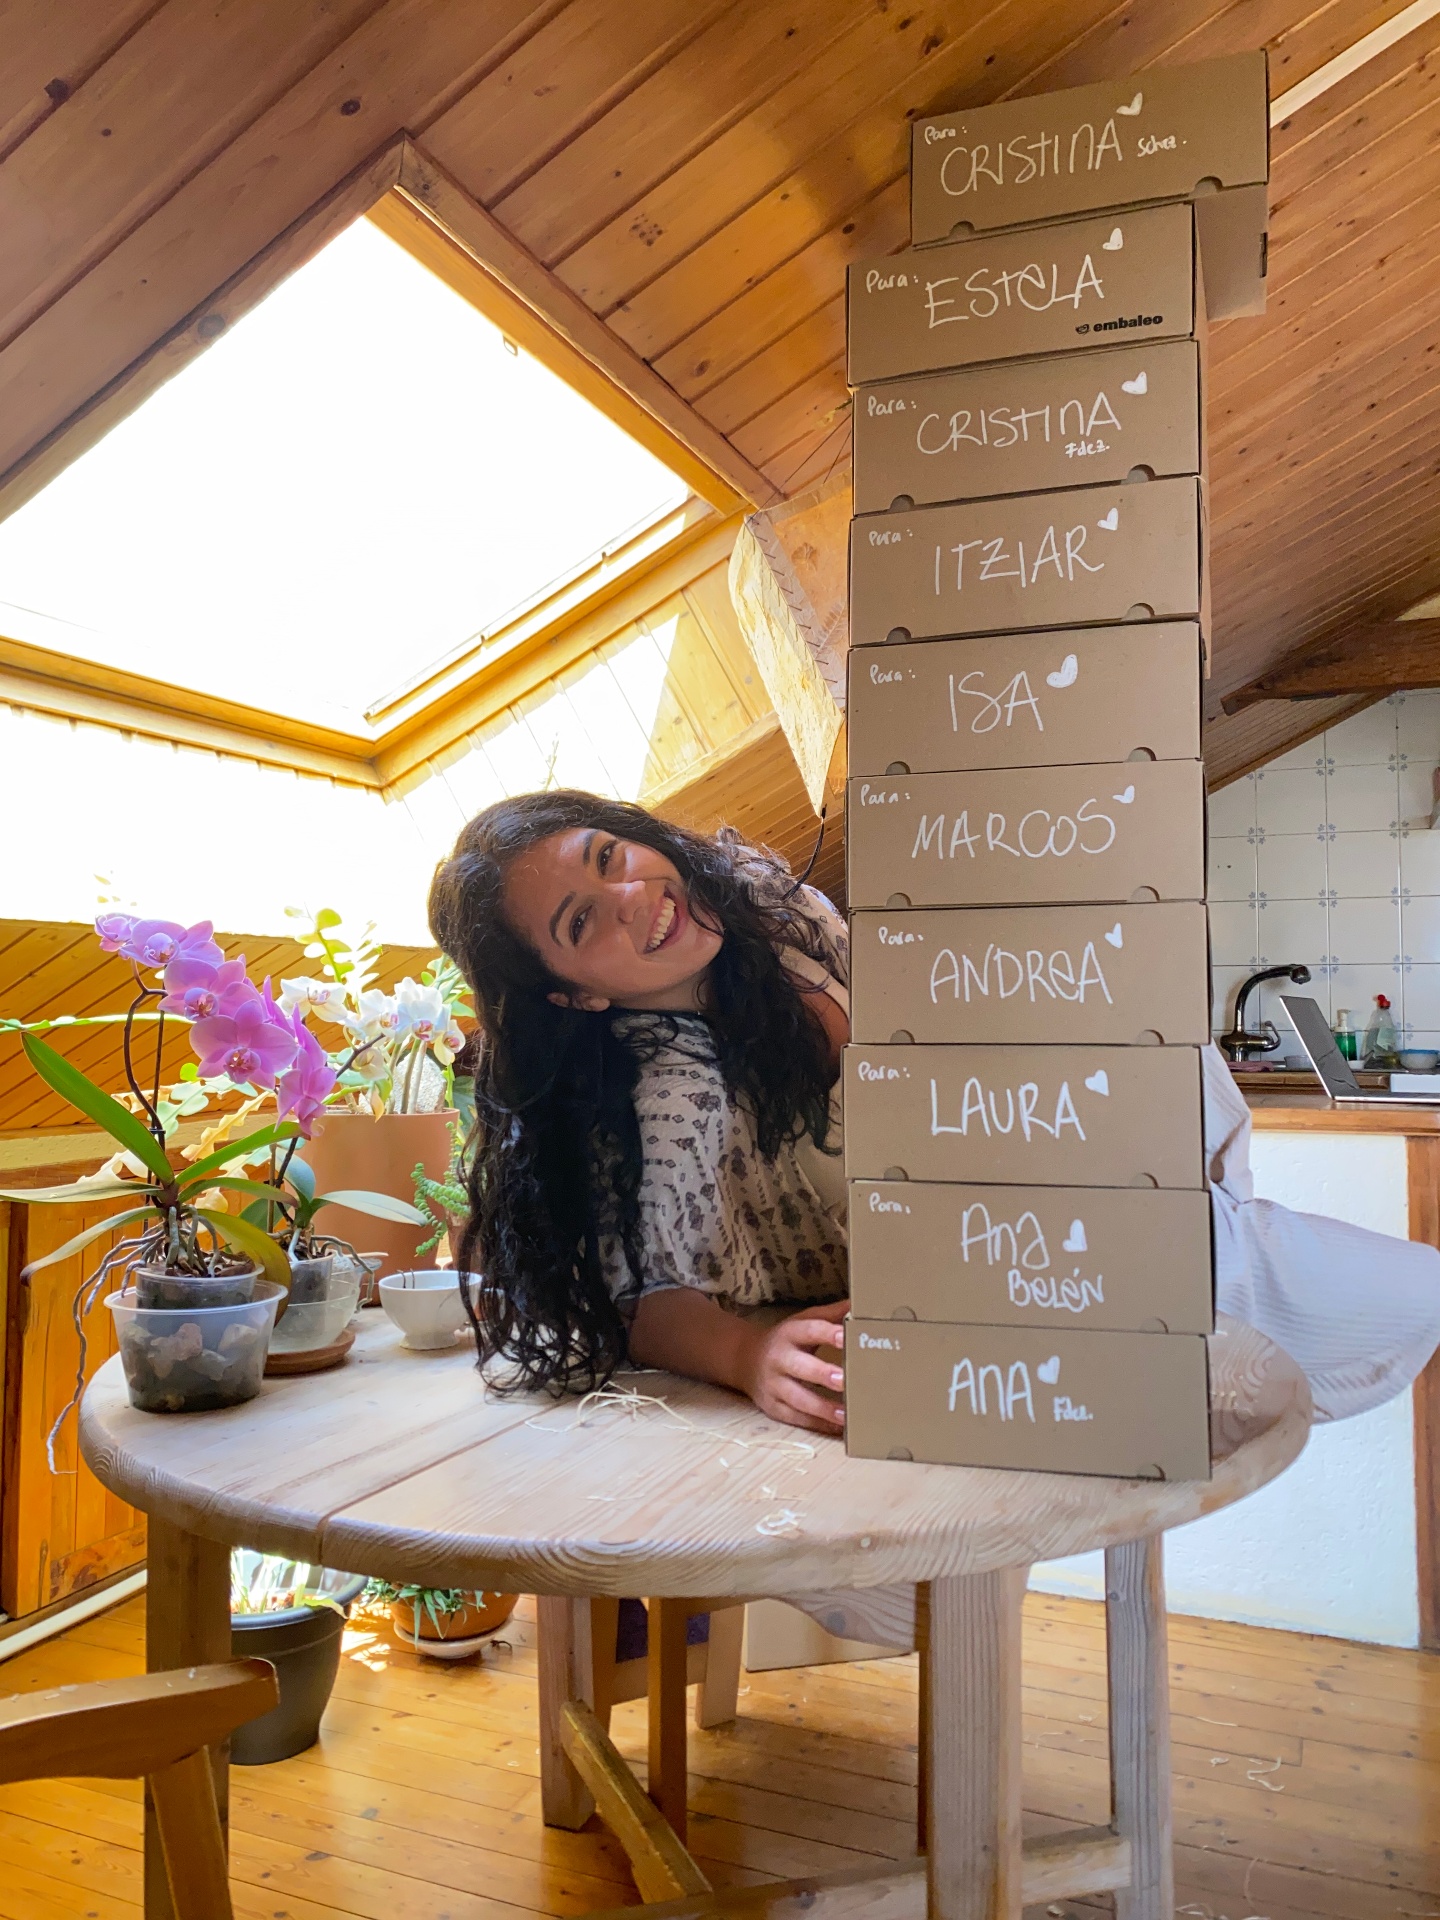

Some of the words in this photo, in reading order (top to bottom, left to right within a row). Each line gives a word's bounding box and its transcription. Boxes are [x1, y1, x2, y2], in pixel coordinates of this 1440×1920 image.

[940, 117, 1123, 196] CRISTINA
[866, 269, 919, 294] Para:
[1093, 314, 1163, 333] embaleo
[867, 394, 917, 418] Para:
[916, 391, 1122, 455] CRISTINA
[934, 525, 1105, 596] ITZIAR
[869, 664, 916, 686] Para:
[948, 670, 1045, 734] ISA
[860, 783, 911, 807] Para:
[911, 798, 1116, 860] MARCOS
[858, 1060, 911, 1082] Para:
[930, 1076, 1087, 1142] LAURA
[948, 1357, 1036, 1423] ANA
